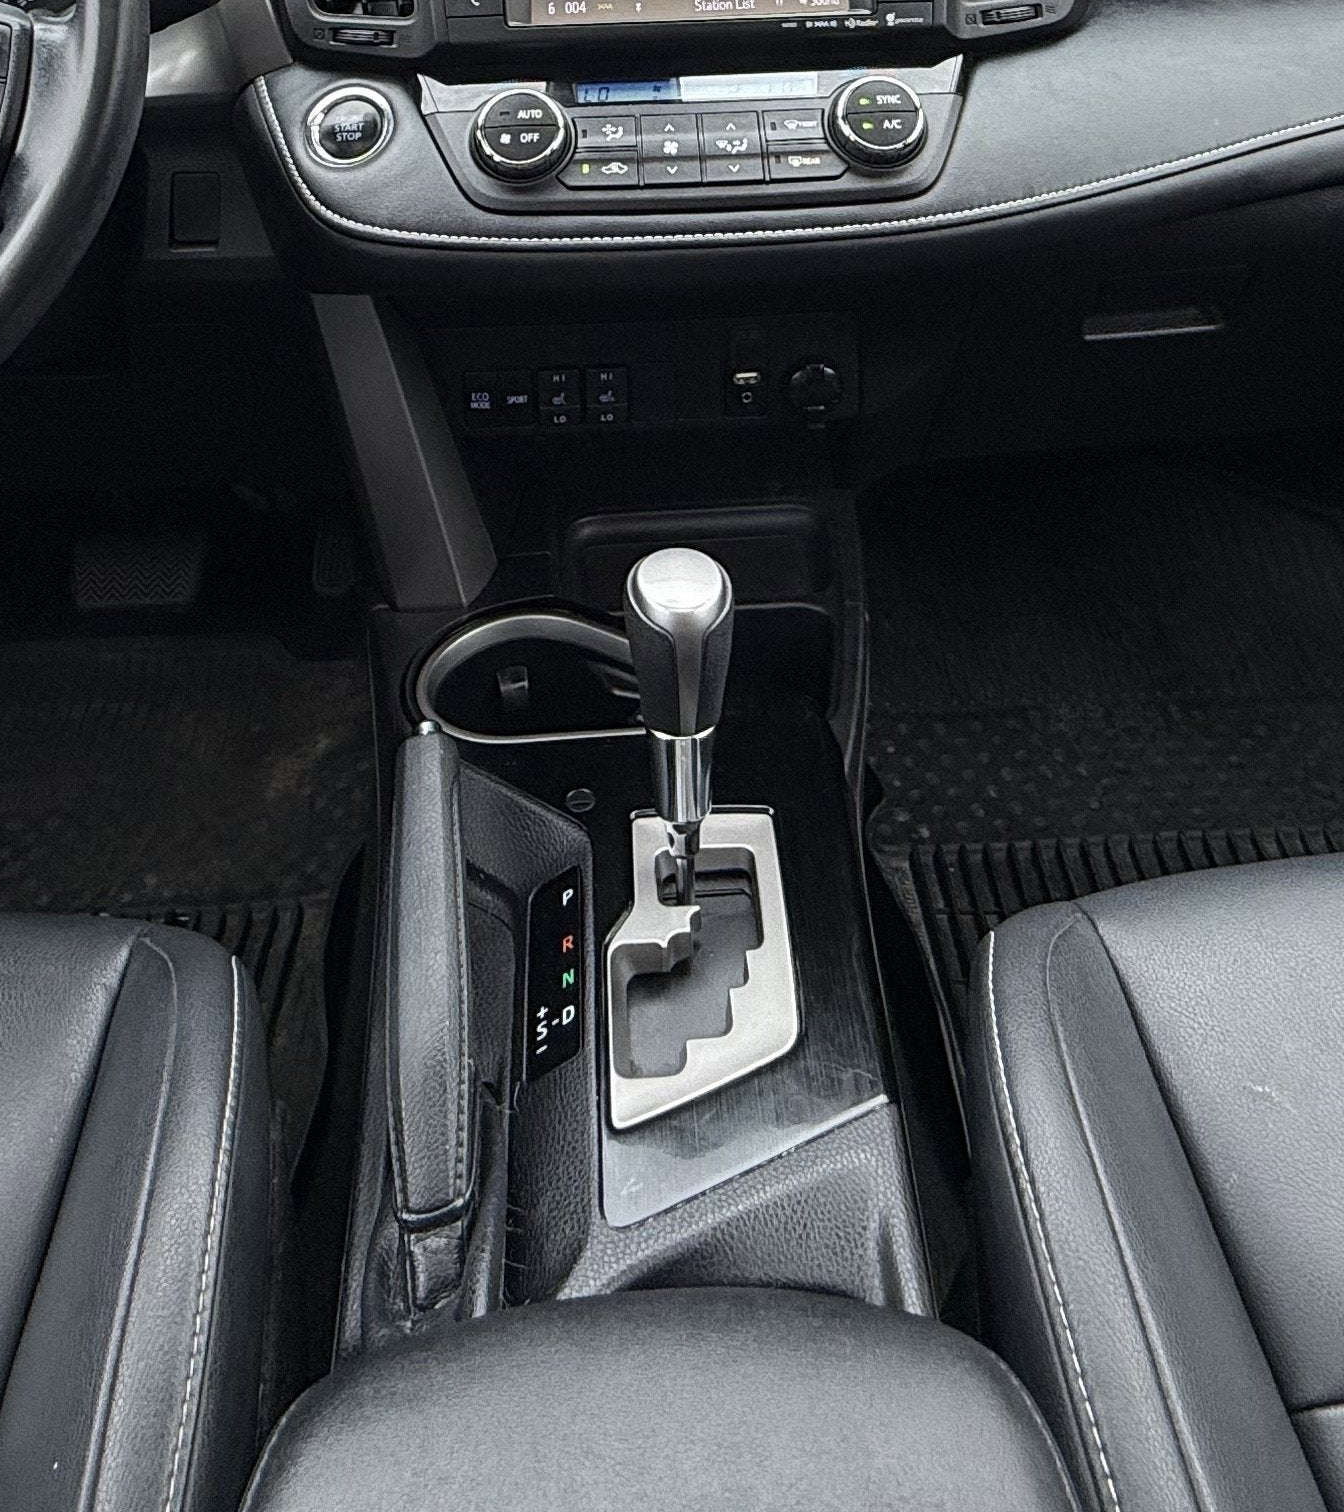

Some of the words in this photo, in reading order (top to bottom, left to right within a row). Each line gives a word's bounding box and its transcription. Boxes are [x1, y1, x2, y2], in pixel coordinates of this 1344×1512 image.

[548, 2, 556, 15] 6
[565, 1, 587, 14] 004
[876, 94, 902, 105] SYNC
[517, 109, 543, 119] AUTO
[334, 122, 365, 133] START
[882, 119, 902, 130] A/C
[336, 132, 362, 142] STOP
[519, 133, 540, 143] OFF
[471, 392, 490, 401] ECO
[506, 394, 528, 405] SPORT
[470, 401, 491, 410] MODE
[554, 415, 567, 424] LO
[600, 413, 614, 422] LO
[562, 888, 574, 907] P
[562, 934, 575, 954] R
[562, 968, 575, 989] N
[561, 1004, 576, 1026] D
